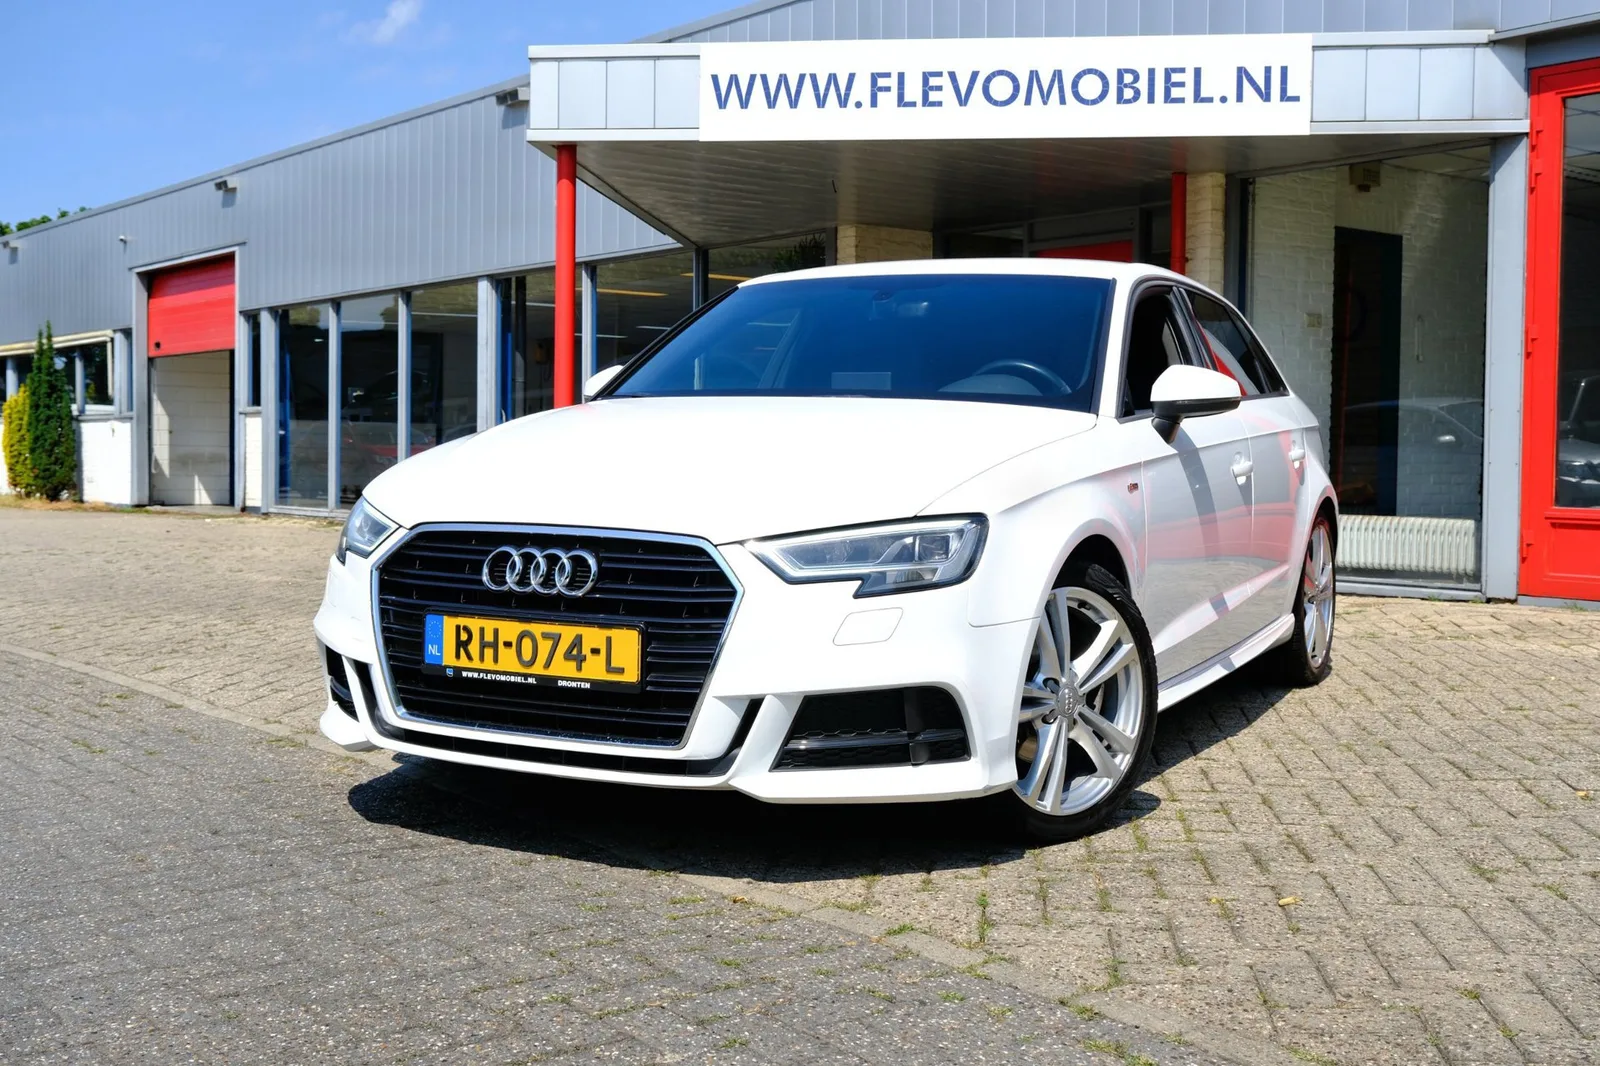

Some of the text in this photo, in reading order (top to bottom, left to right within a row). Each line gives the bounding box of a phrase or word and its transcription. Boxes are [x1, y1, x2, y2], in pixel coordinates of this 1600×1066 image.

[710, 65, 1301, 110] WWW.FLEVOMOBIEL.NL
[428, 644, 441, 656] NL
[455, 624, 625, 674] RH-074-L
[461, 671, 591, 689] WWW.FLEVOMOBIEL.NL DRONTEN
